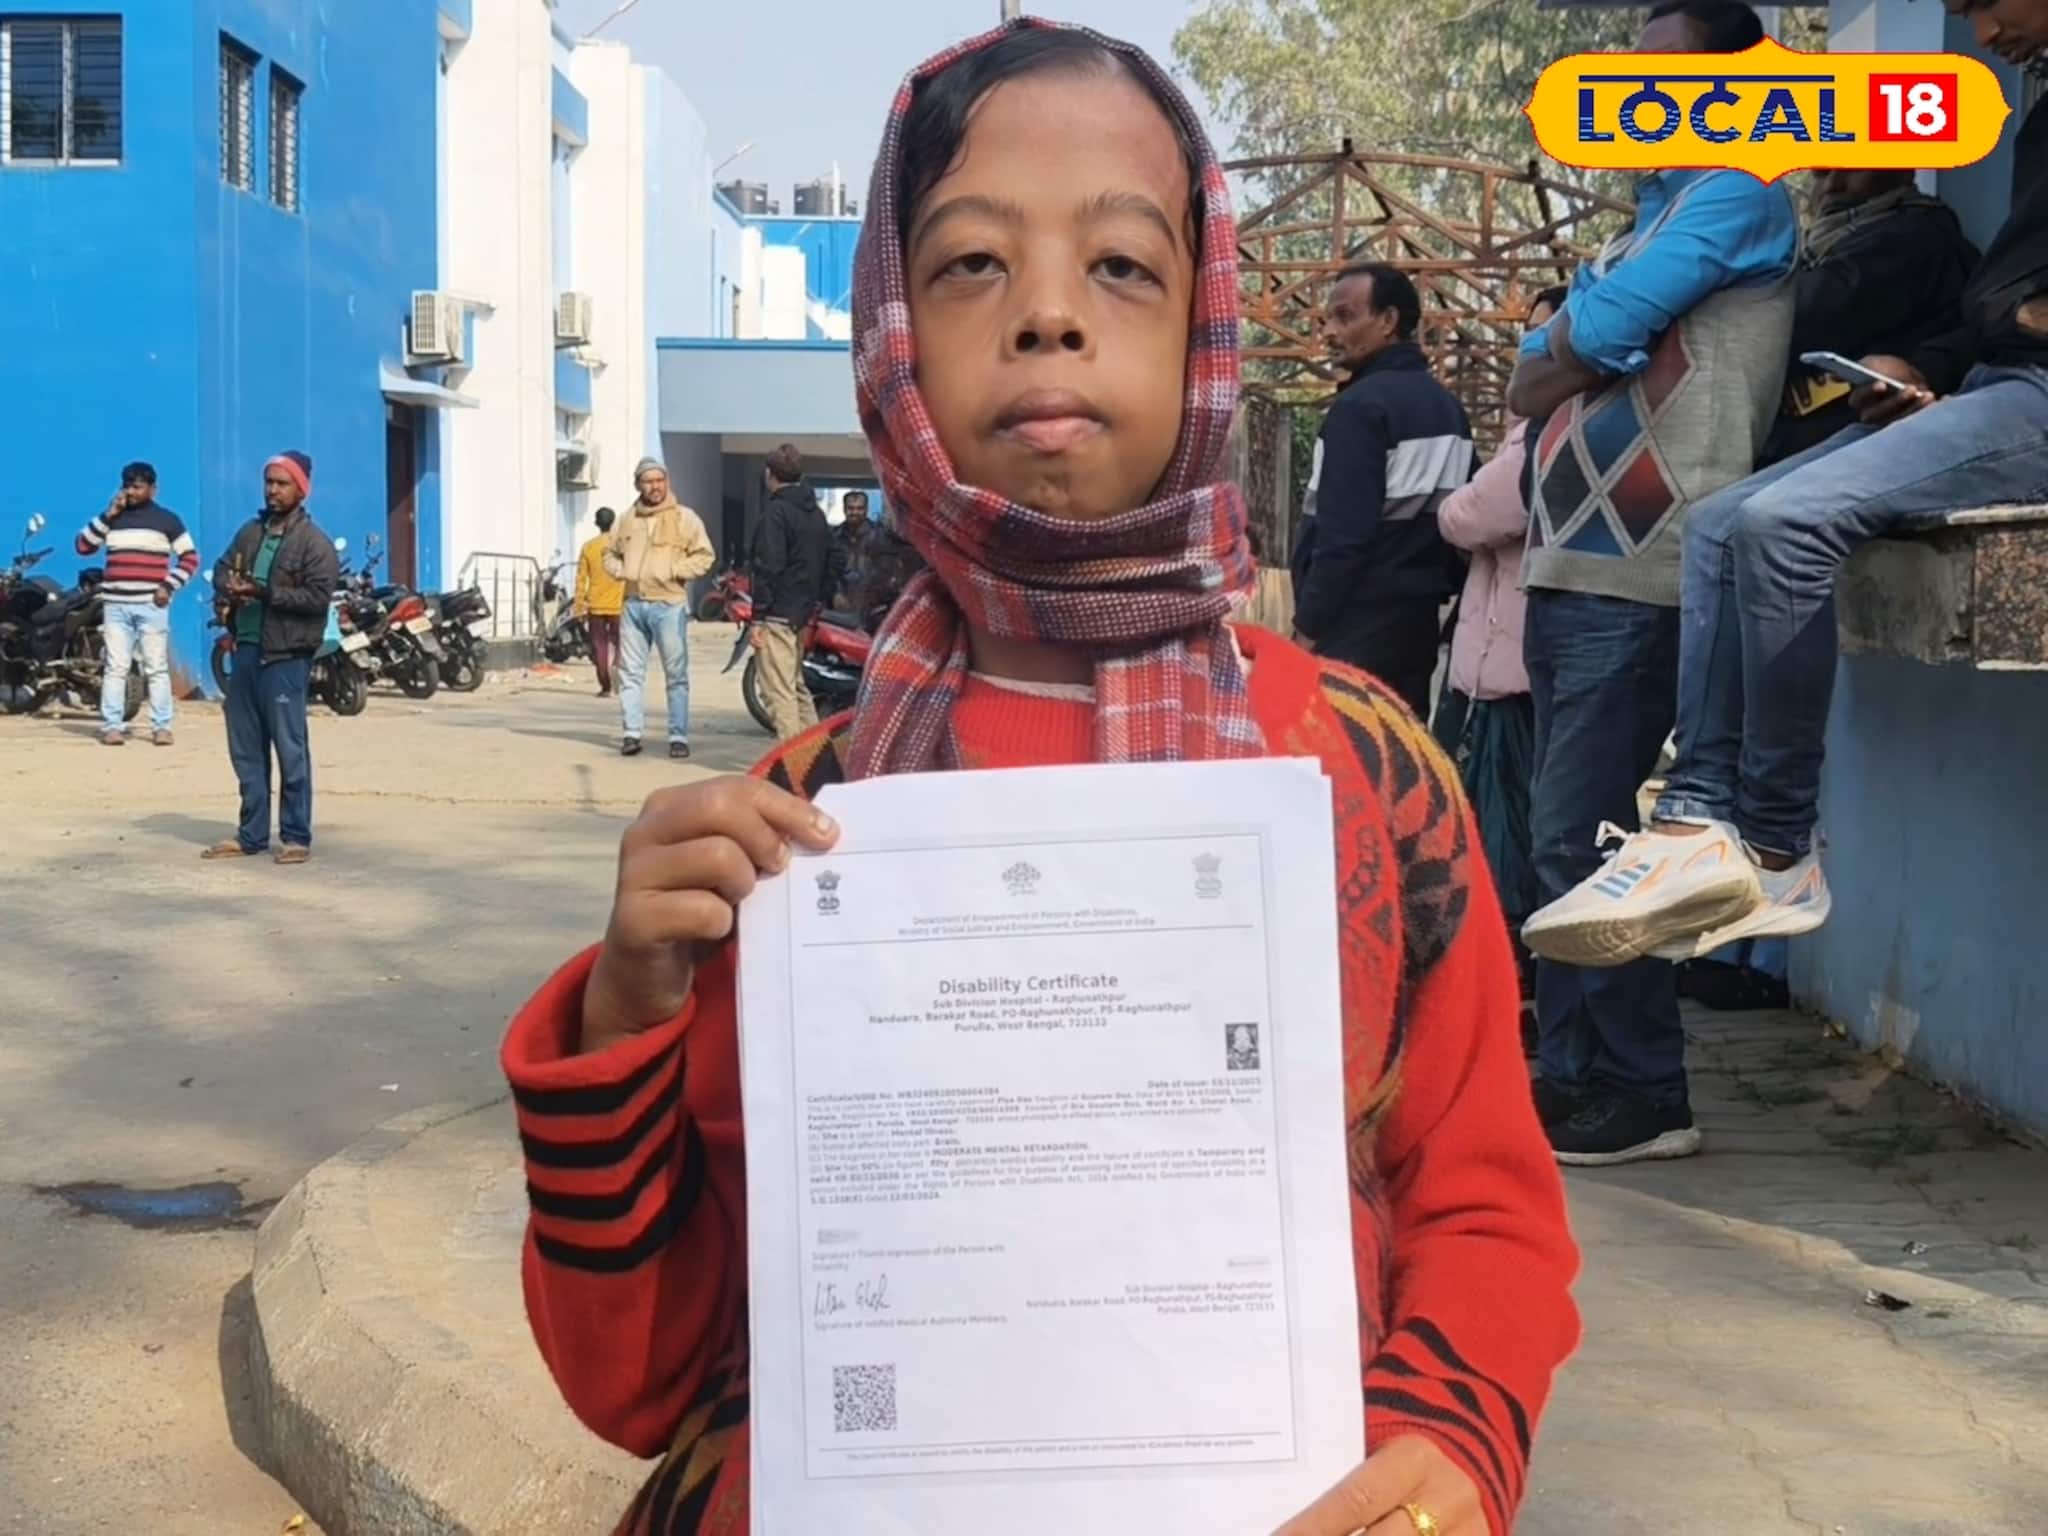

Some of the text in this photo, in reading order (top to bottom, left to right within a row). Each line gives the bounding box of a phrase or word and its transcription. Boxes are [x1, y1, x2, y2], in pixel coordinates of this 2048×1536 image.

[939, 973, 1119, 995] Disability Certificate
[933, 999, 953, 1009] Sub
[955, 998, 997, 1008] Division
[1000, 996, 1042, 1008] Hospital
